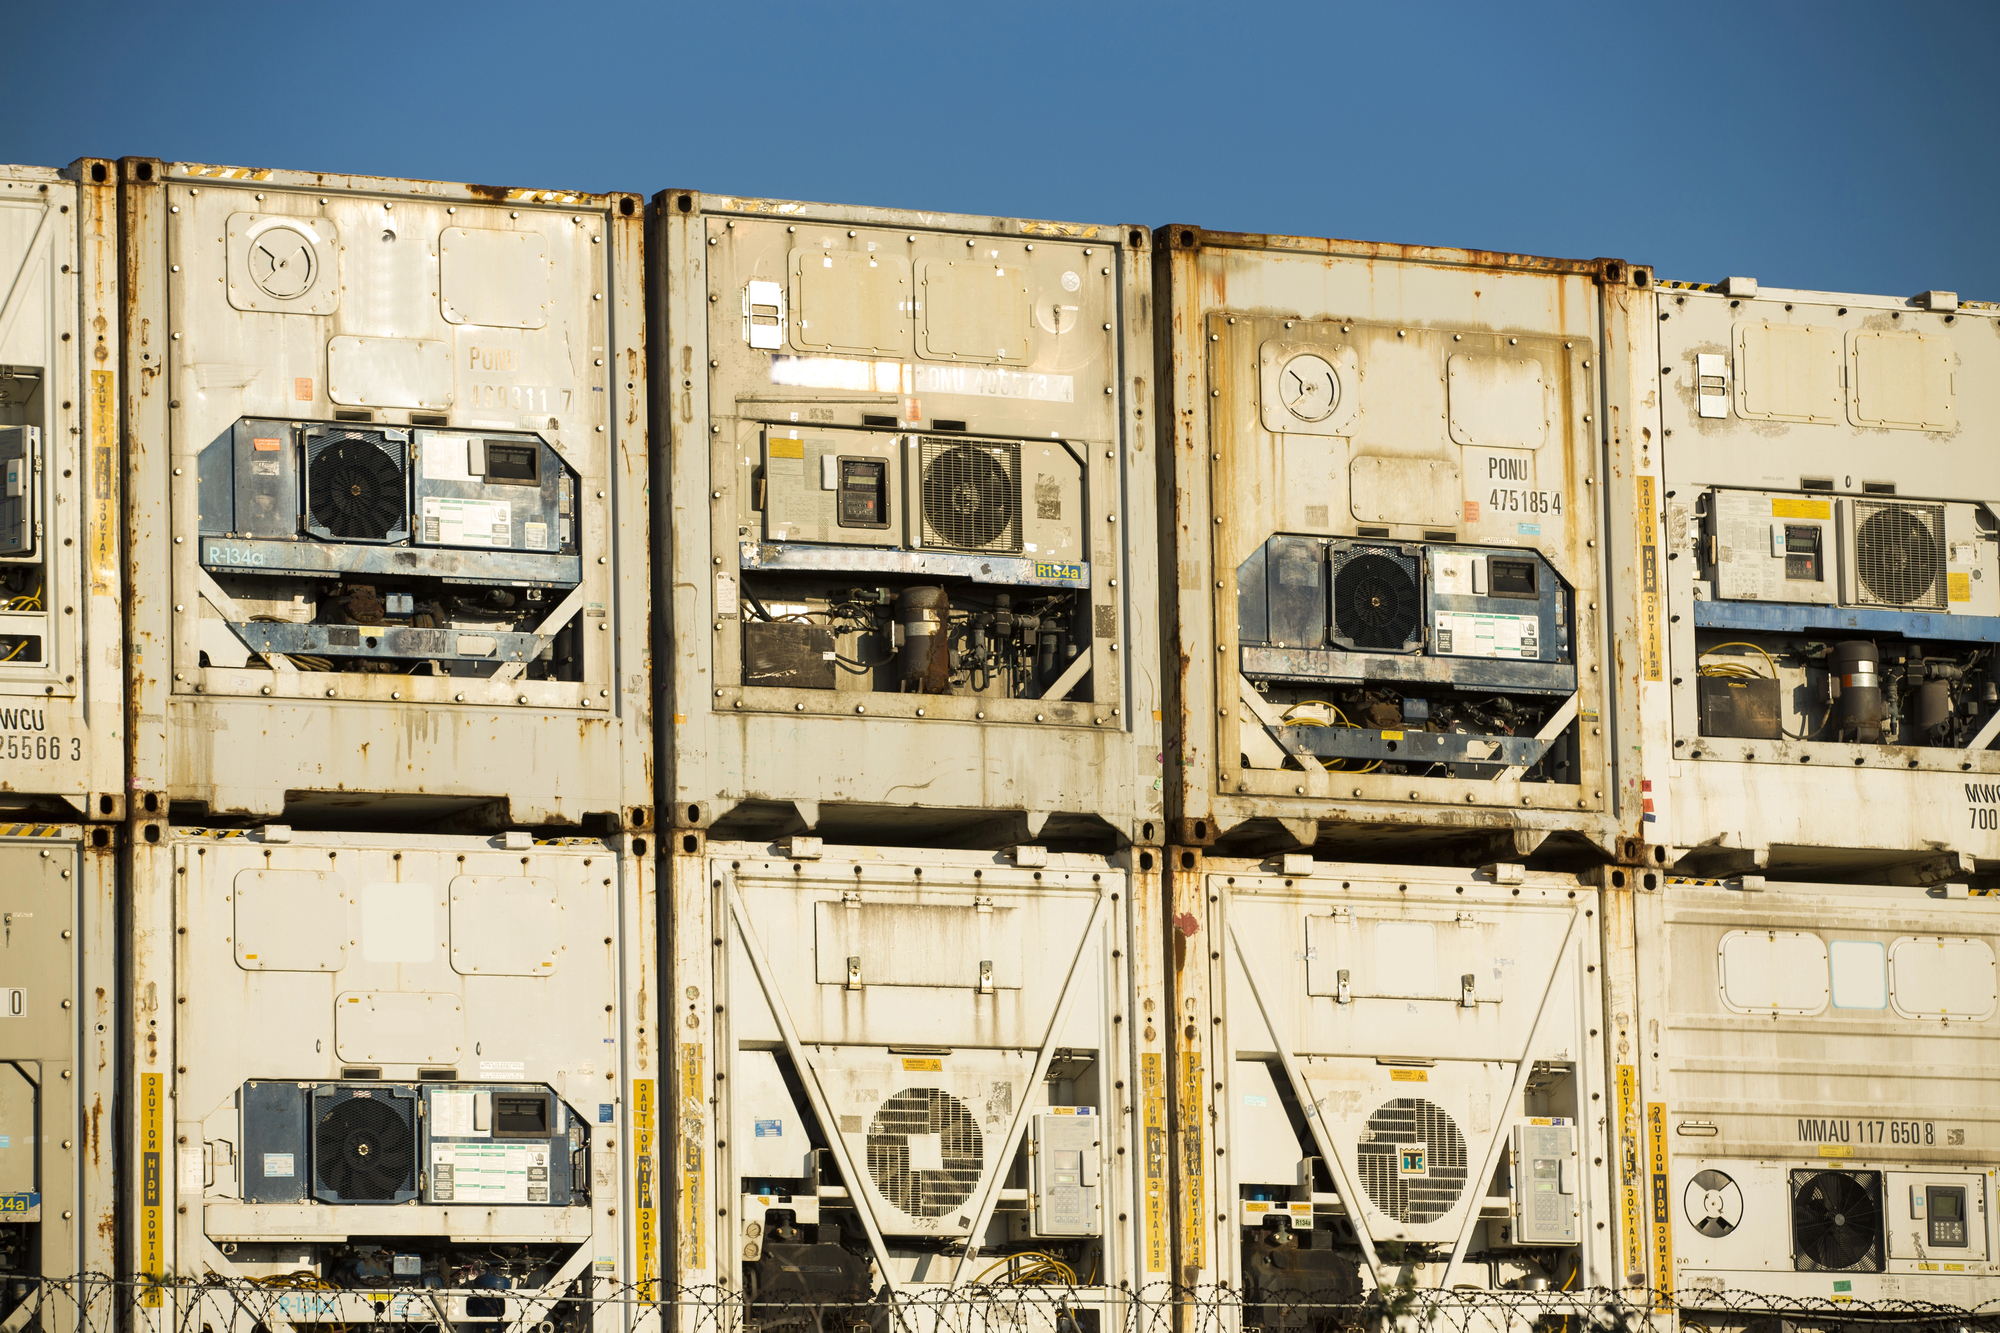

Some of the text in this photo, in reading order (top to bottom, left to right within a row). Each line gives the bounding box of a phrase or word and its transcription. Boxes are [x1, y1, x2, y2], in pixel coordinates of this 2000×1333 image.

[469, 346, 519, 372] PONU
[469, 385, 572, 413] 499311 7
[1488, 456, 1528, 481] PONU
[1489, 488, 1549, 514] 475185
[1552, 492, 1562, 515] 4
[208, 546, 265, 566] R-134a
[1037, 564, 1079, 579] R134a
[71, 737, 81, 761] 3
[1968, 807, 1998, 830] 700
[1798, 1119, 1934, 1145] MMAU 117 650 8
[1295, 1219, 1312, 1227] R134a
[279, 1296, 335, 1315] R-134a
